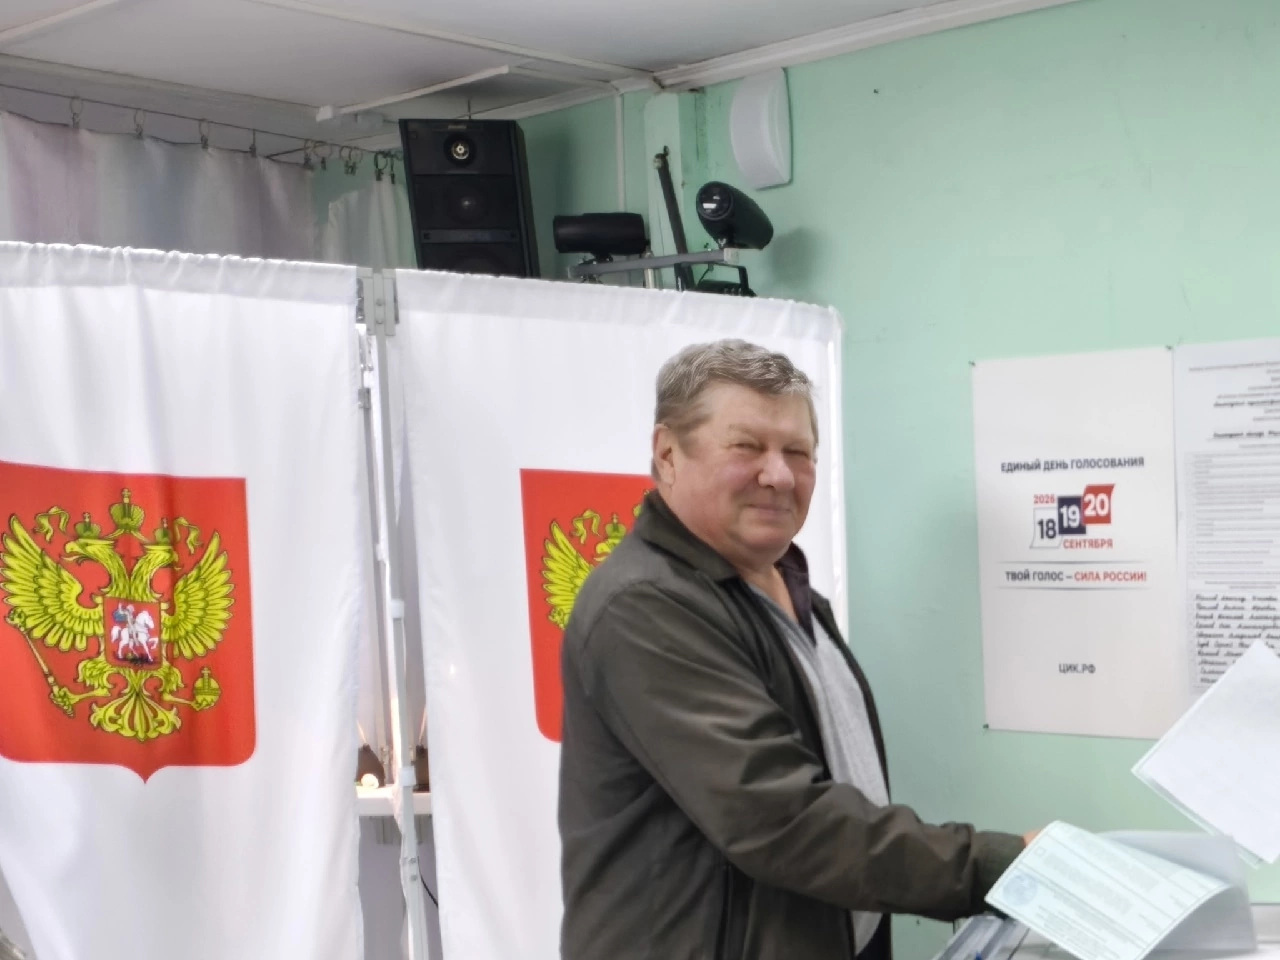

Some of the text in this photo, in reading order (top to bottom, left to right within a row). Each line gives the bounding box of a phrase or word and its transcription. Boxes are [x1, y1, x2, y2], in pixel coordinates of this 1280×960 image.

[1001, 457, 1144, 474] ЕДИНЫЙ ДЕНЬ ГОЛОСОВАНИЯ
[1033, 494, 1056, 504] 2026
[1037, 494, 1109, 539] 18 19 20
[1063, 539, 1113, 549] СЕНТЯБРЯ
[1006, 570, 1031, 582] ТВОЙ
[1033, 571, 1064, 582] ГОЛОС
[1074, 571, 1100, 582] СИЛА
[1103, 571, 1147, 582] РОССИИ!
[1059, 663, 1096, 676] ЦИК.РФ
